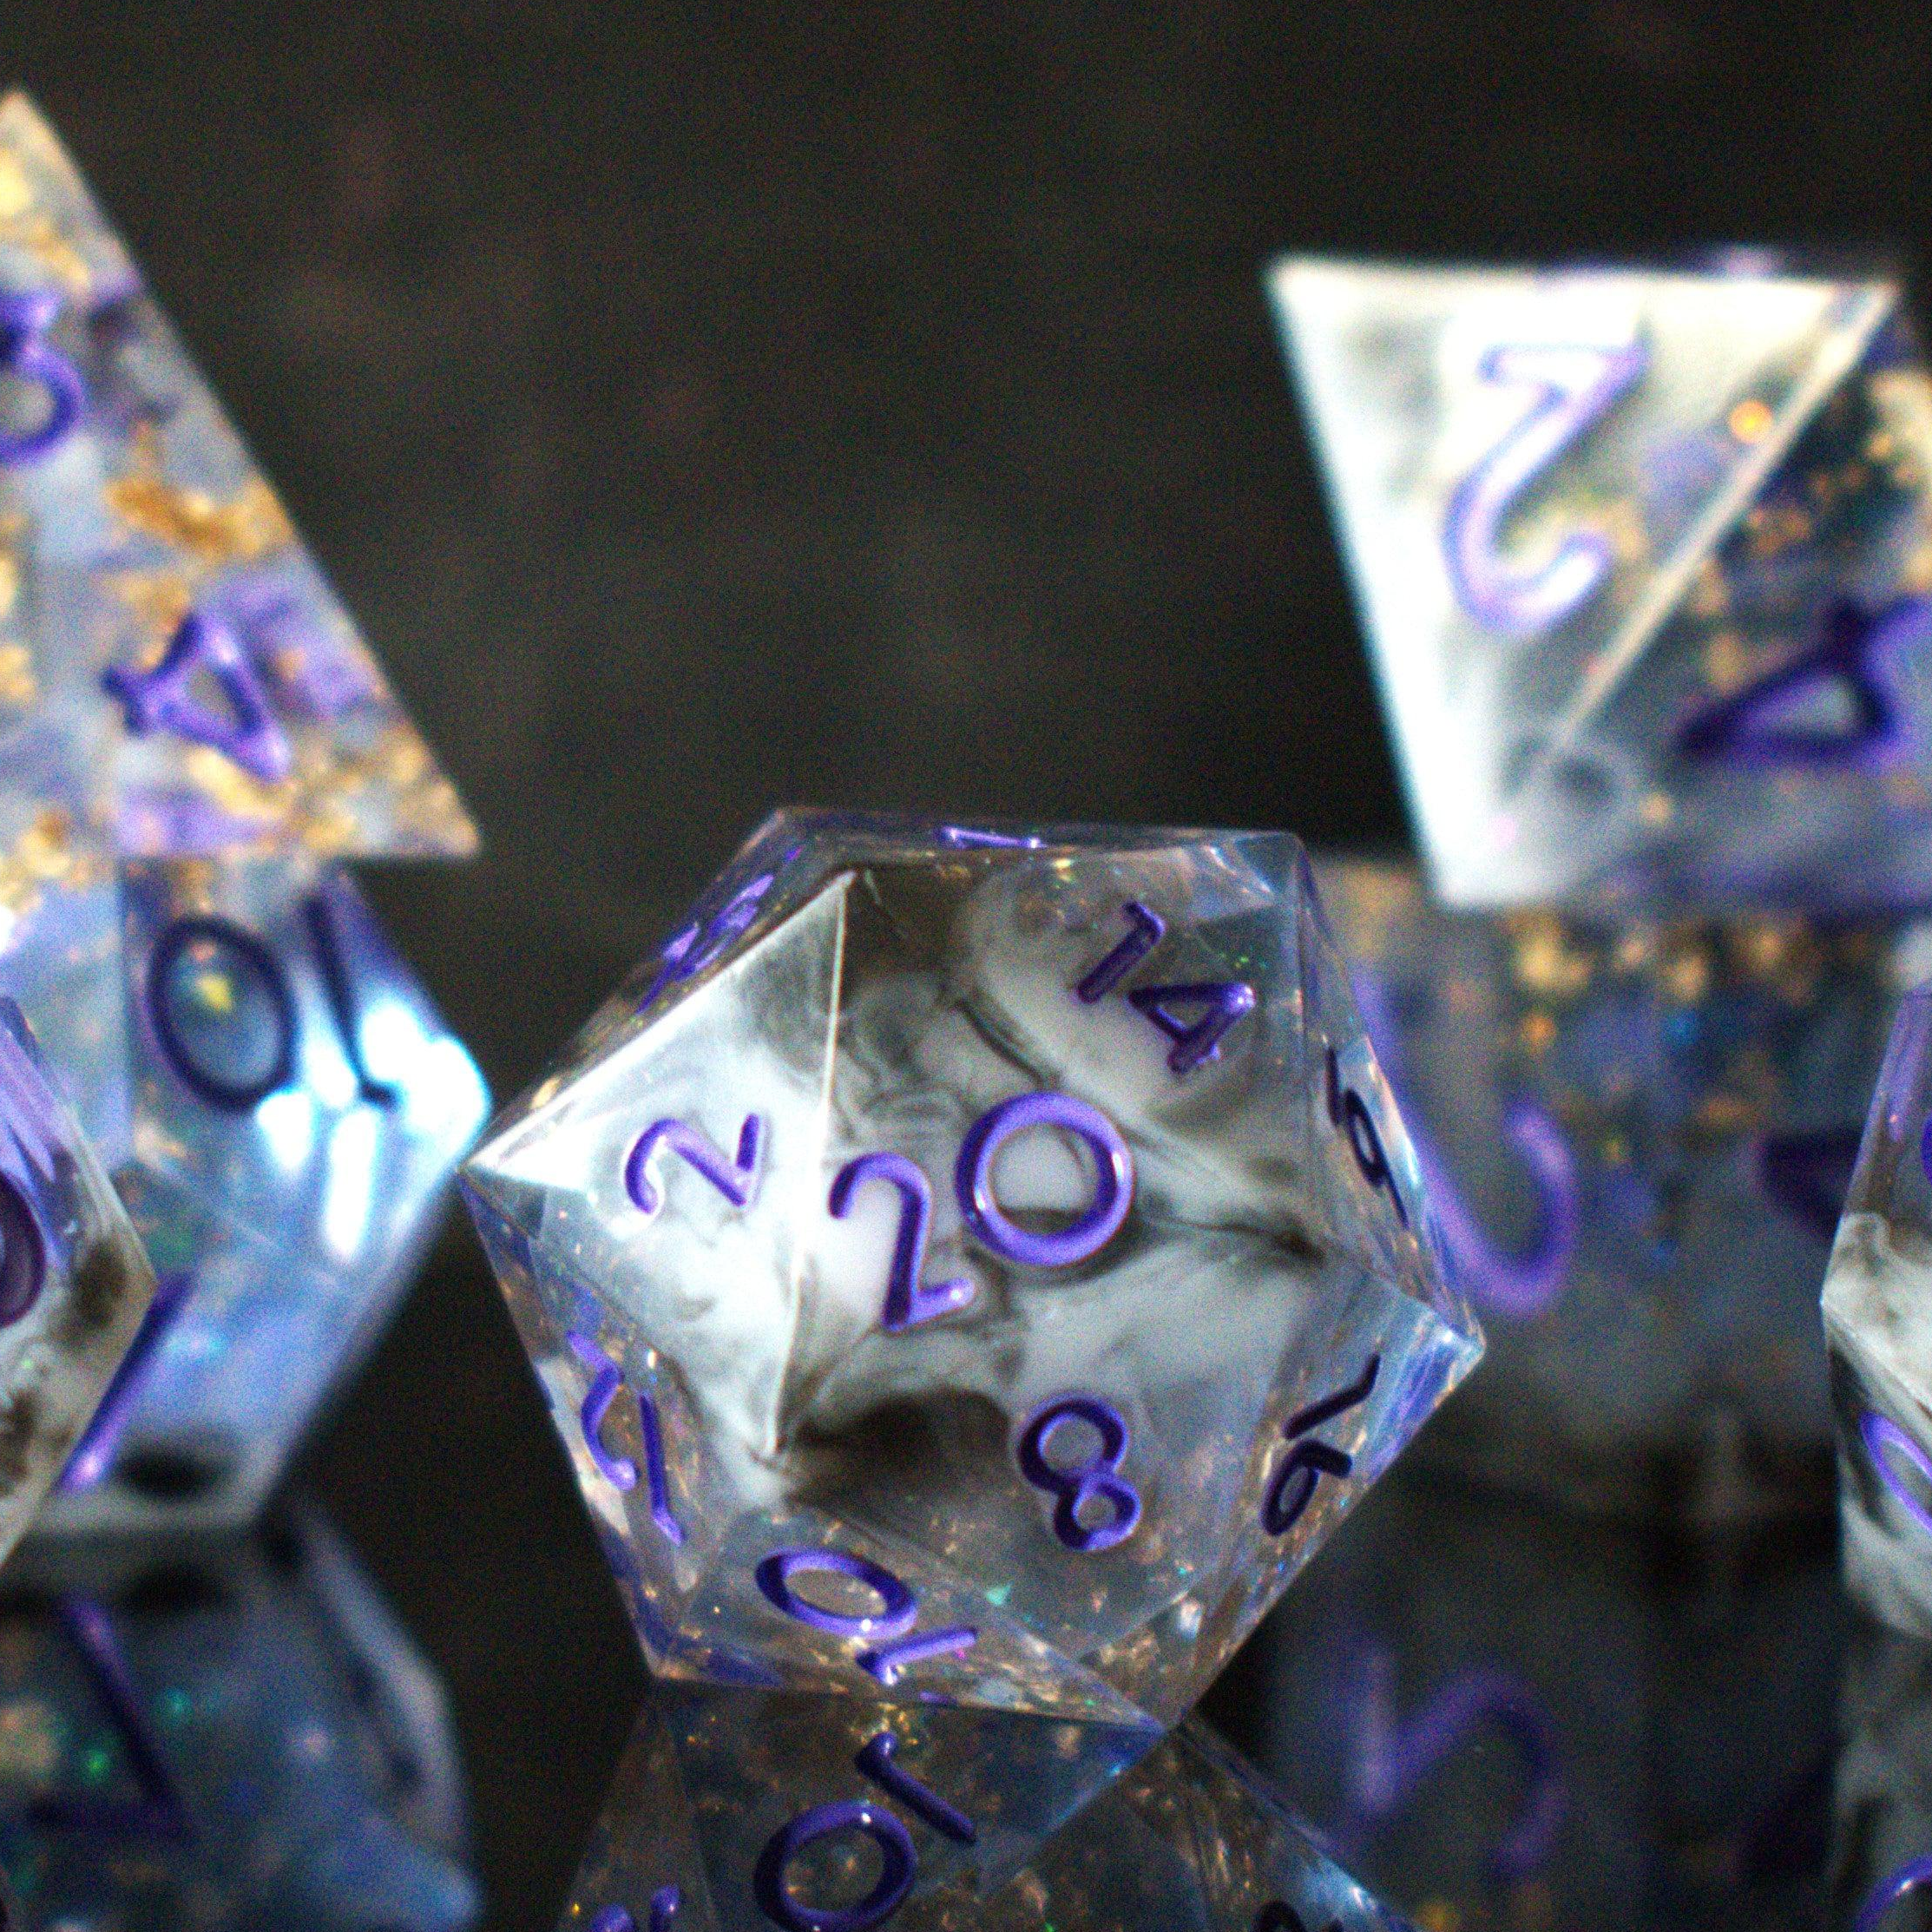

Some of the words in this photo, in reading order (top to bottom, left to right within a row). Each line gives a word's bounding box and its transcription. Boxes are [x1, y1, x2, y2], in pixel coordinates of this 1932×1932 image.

[102, 608, 292, 783] 4
[1076, 899, 1258, 1076] 14
[623, 1113, 767, 1215] 2
[828, 1092, 1135, 1332] 20
[1017, 1393, 1143, 1552] 8
